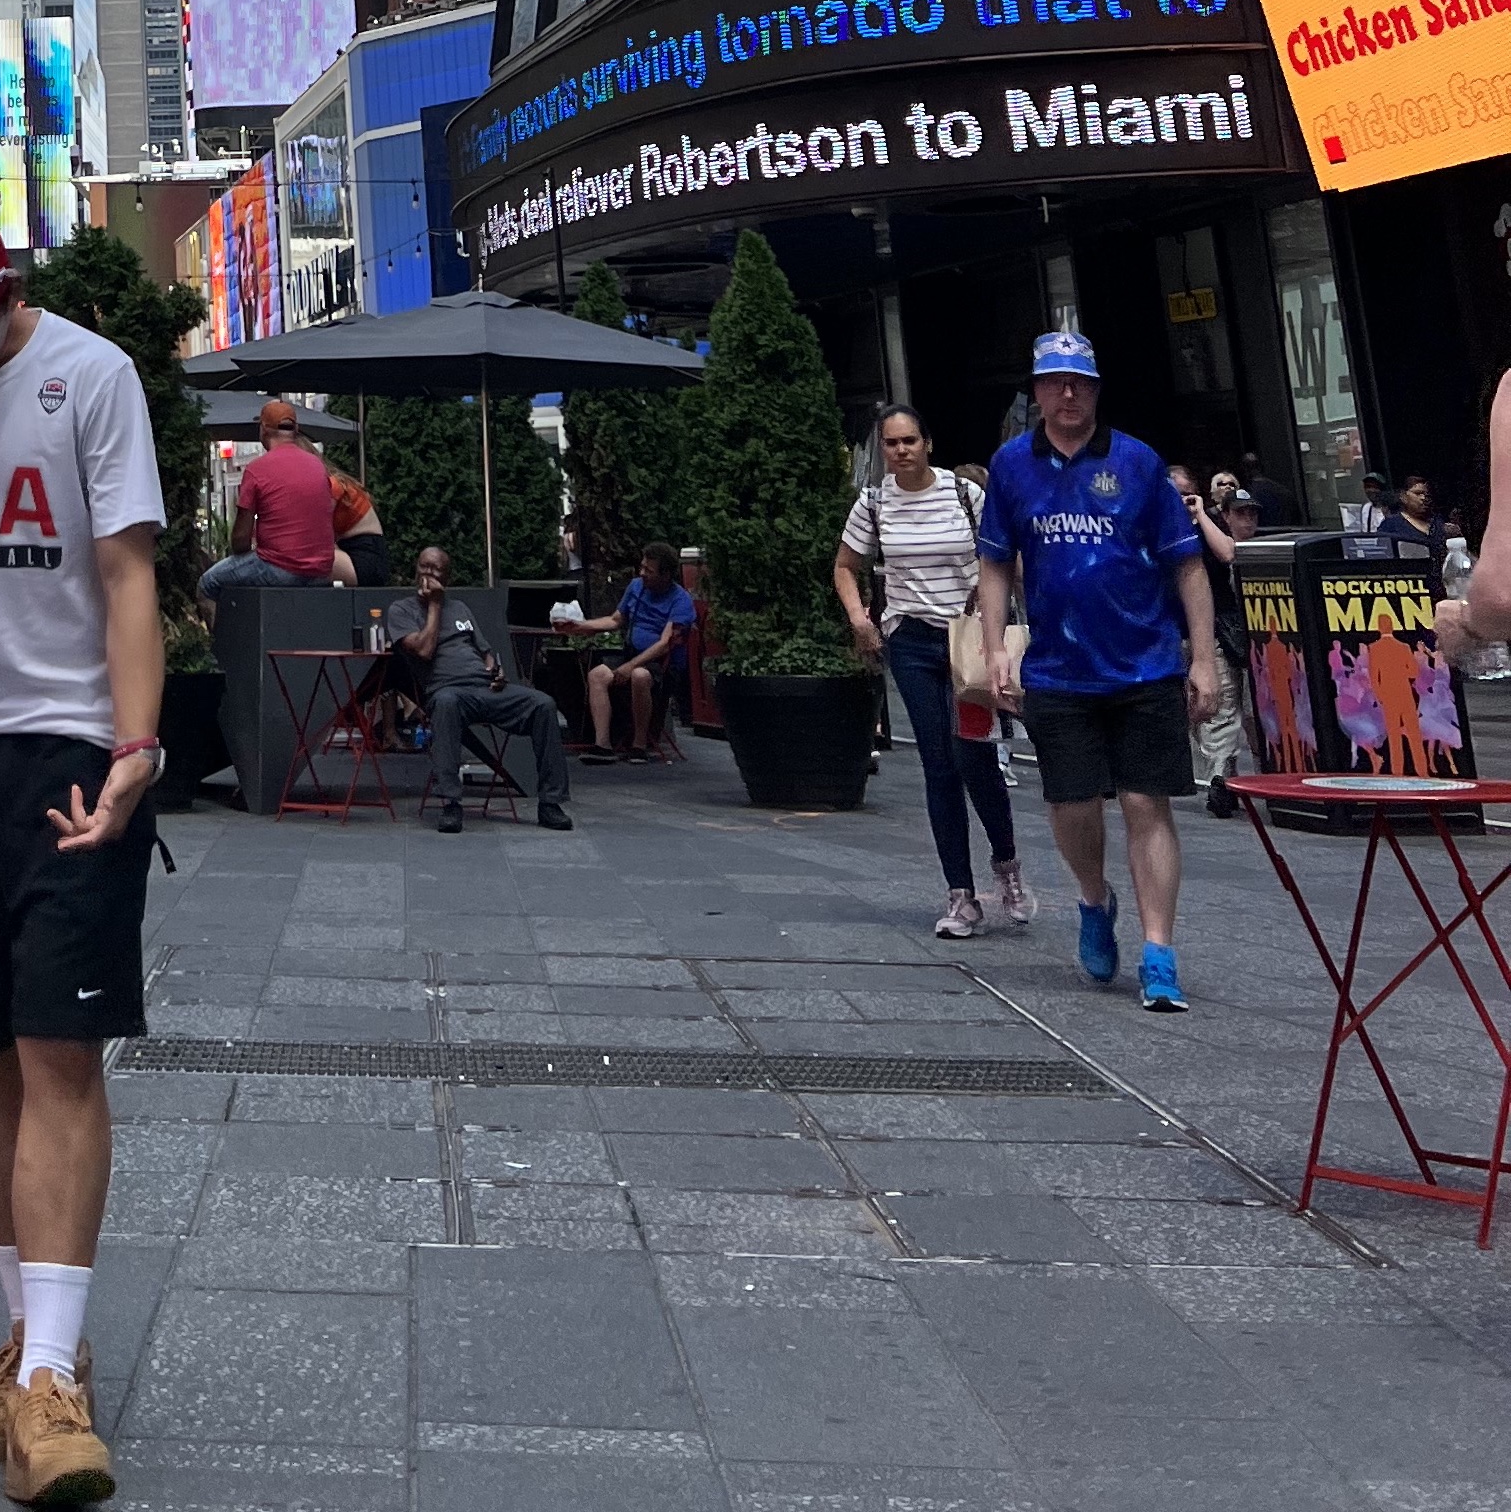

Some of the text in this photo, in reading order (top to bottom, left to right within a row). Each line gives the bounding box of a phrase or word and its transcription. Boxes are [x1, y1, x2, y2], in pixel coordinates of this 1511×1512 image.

[582, 30, 707, 90] surviving
[1288, 6, 1416, 77] Chicken
[555, 164, 635, 226] reliever
[640, 114, 888, 202] Robertson
[907, 102, 979, 162] to
[1005, 72, 1255, 156] Miami
[1312, 92, 1442, 160] Chicken
[1044, 534, 1102, 545] LAGER
[1244, 597, 1299, 632] MAN
[1325, 596, 1435, 632] MAN
